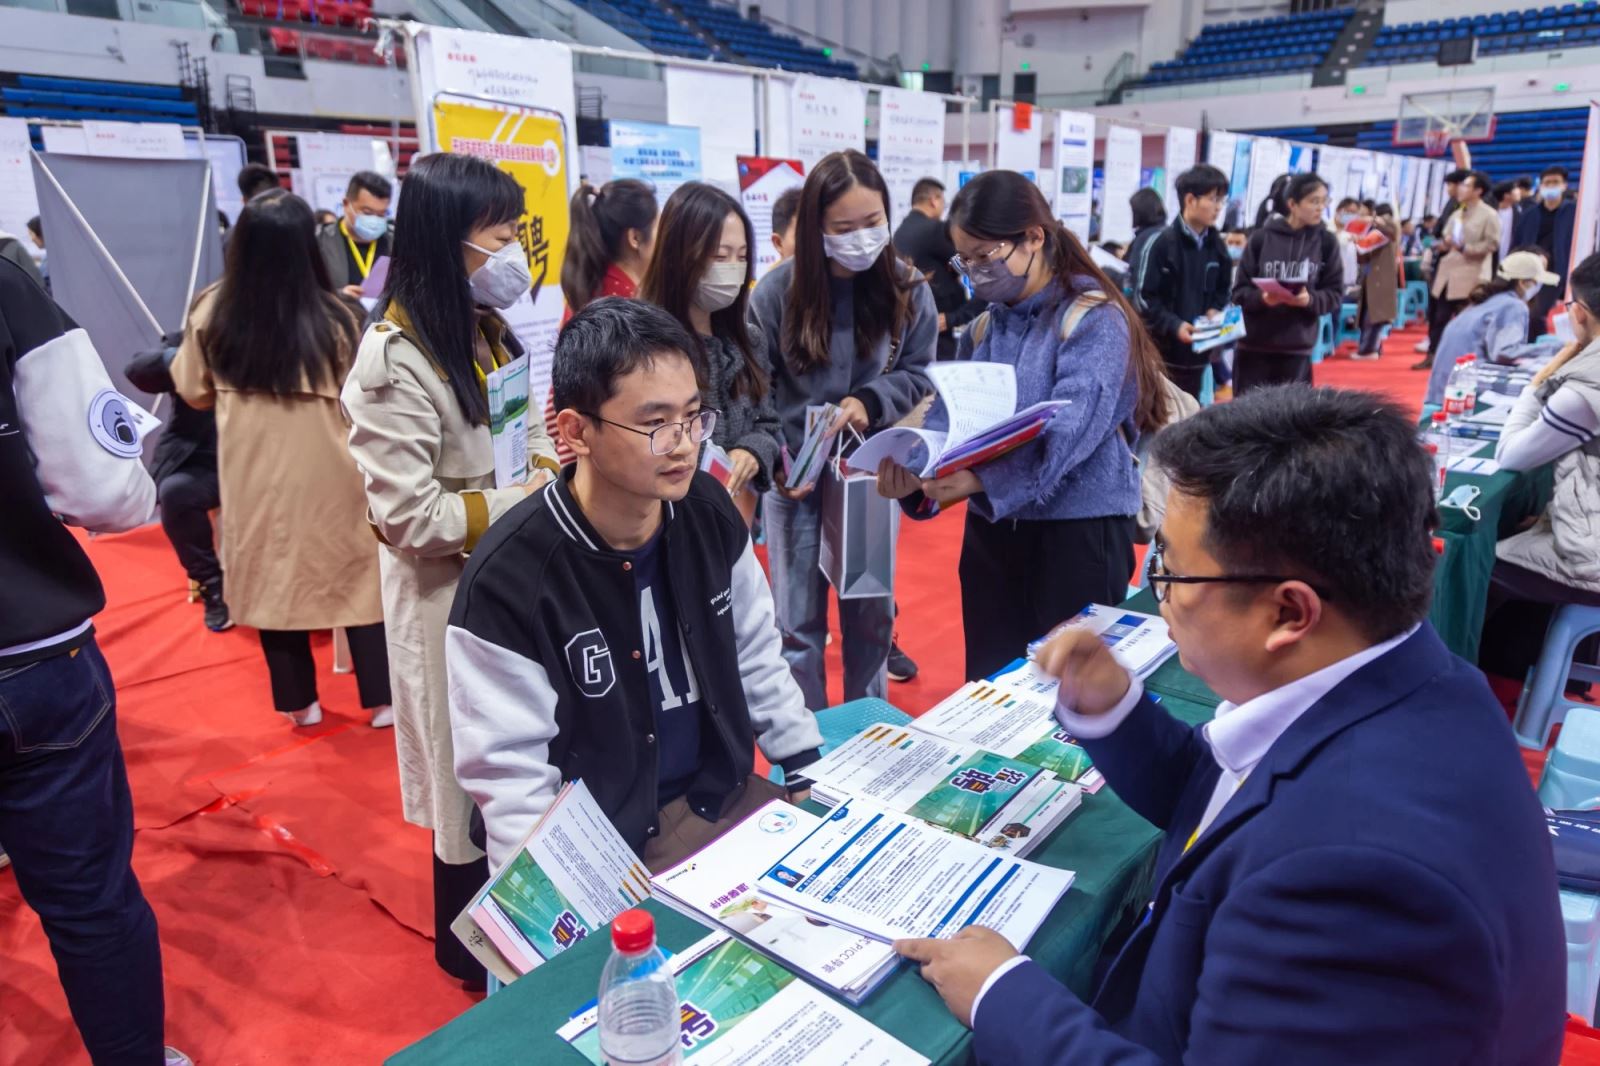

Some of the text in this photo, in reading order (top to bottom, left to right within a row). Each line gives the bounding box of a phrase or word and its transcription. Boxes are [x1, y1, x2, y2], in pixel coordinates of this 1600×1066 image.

[564, 628, 616, 698] G
[951, 767, 1029, 794] 招聘
[710, 882, 750, 910] 温馨相伴
